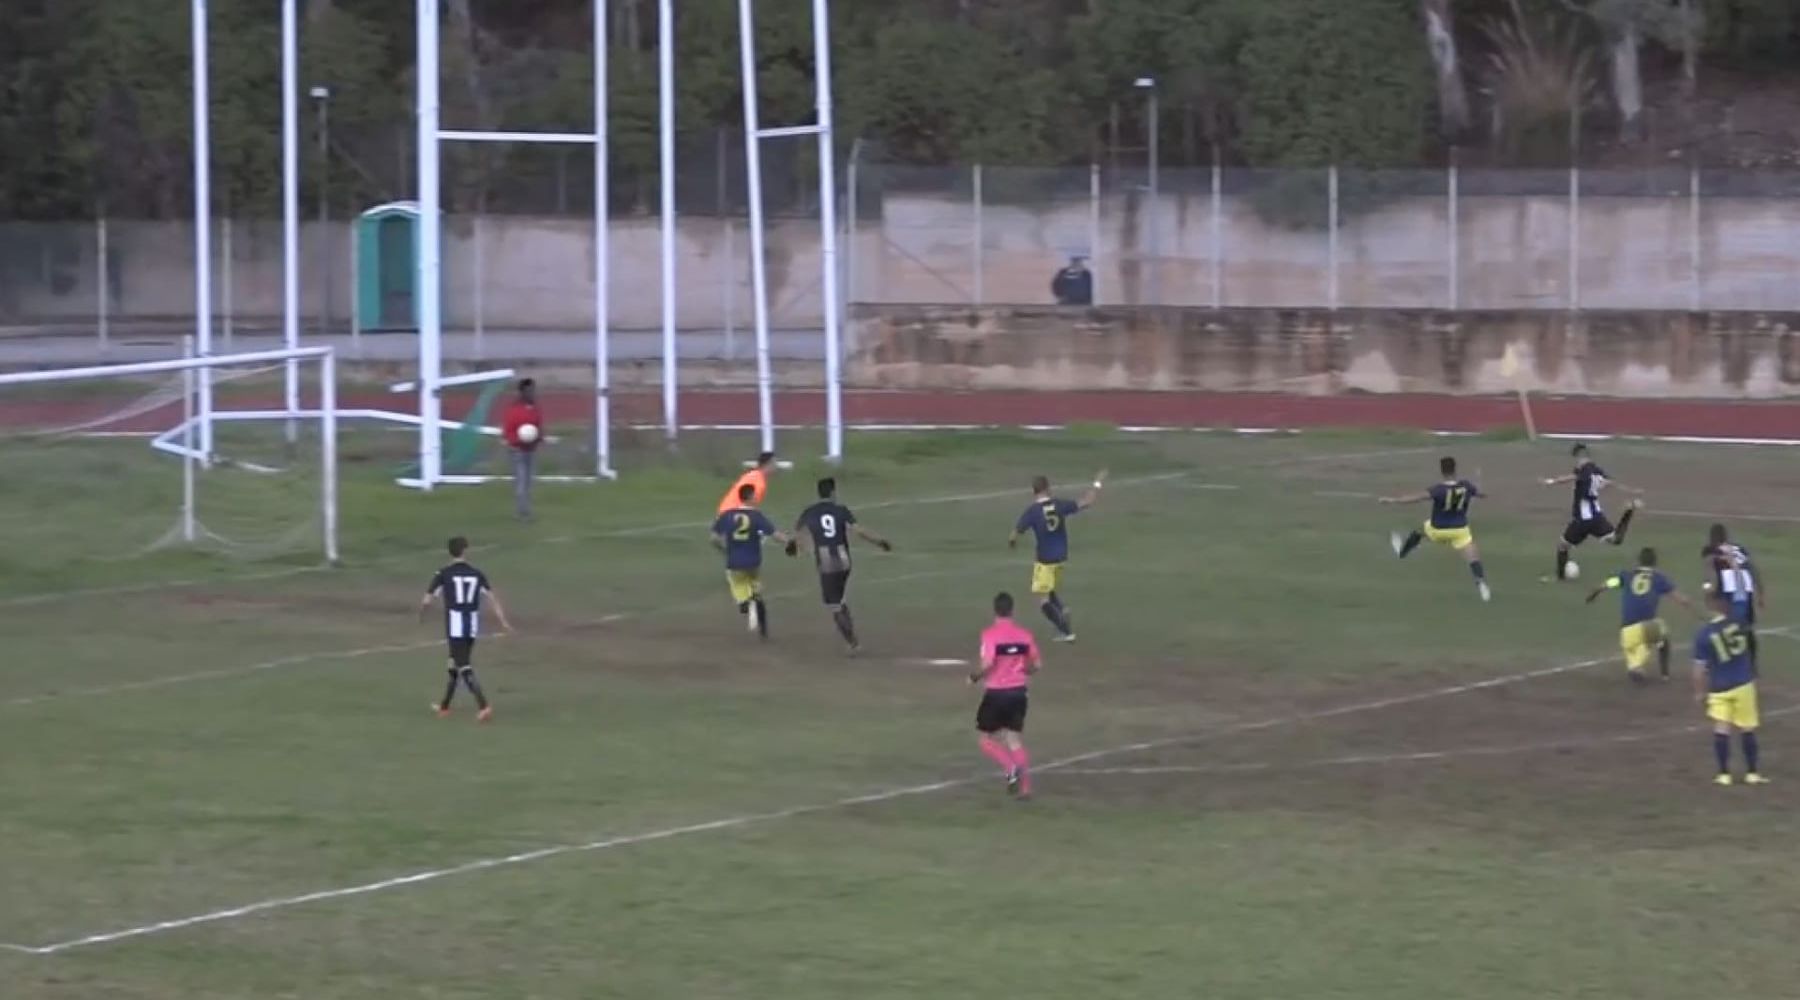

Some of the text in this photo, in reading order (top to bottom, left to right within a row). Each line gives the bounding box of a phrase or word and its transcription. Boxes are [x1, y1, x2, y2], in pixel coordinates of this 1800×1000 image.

[1443, 488, 1468, 511] 17
[732, 515, 751, 540] 2
[820, 514, 837, 538] 9
[1041, 506, 1060, 532] 5
[453, 576, 477, 603] 17
[1631, 574, 1652, 596] 6
[1709, 625, 1746, 664] 15
